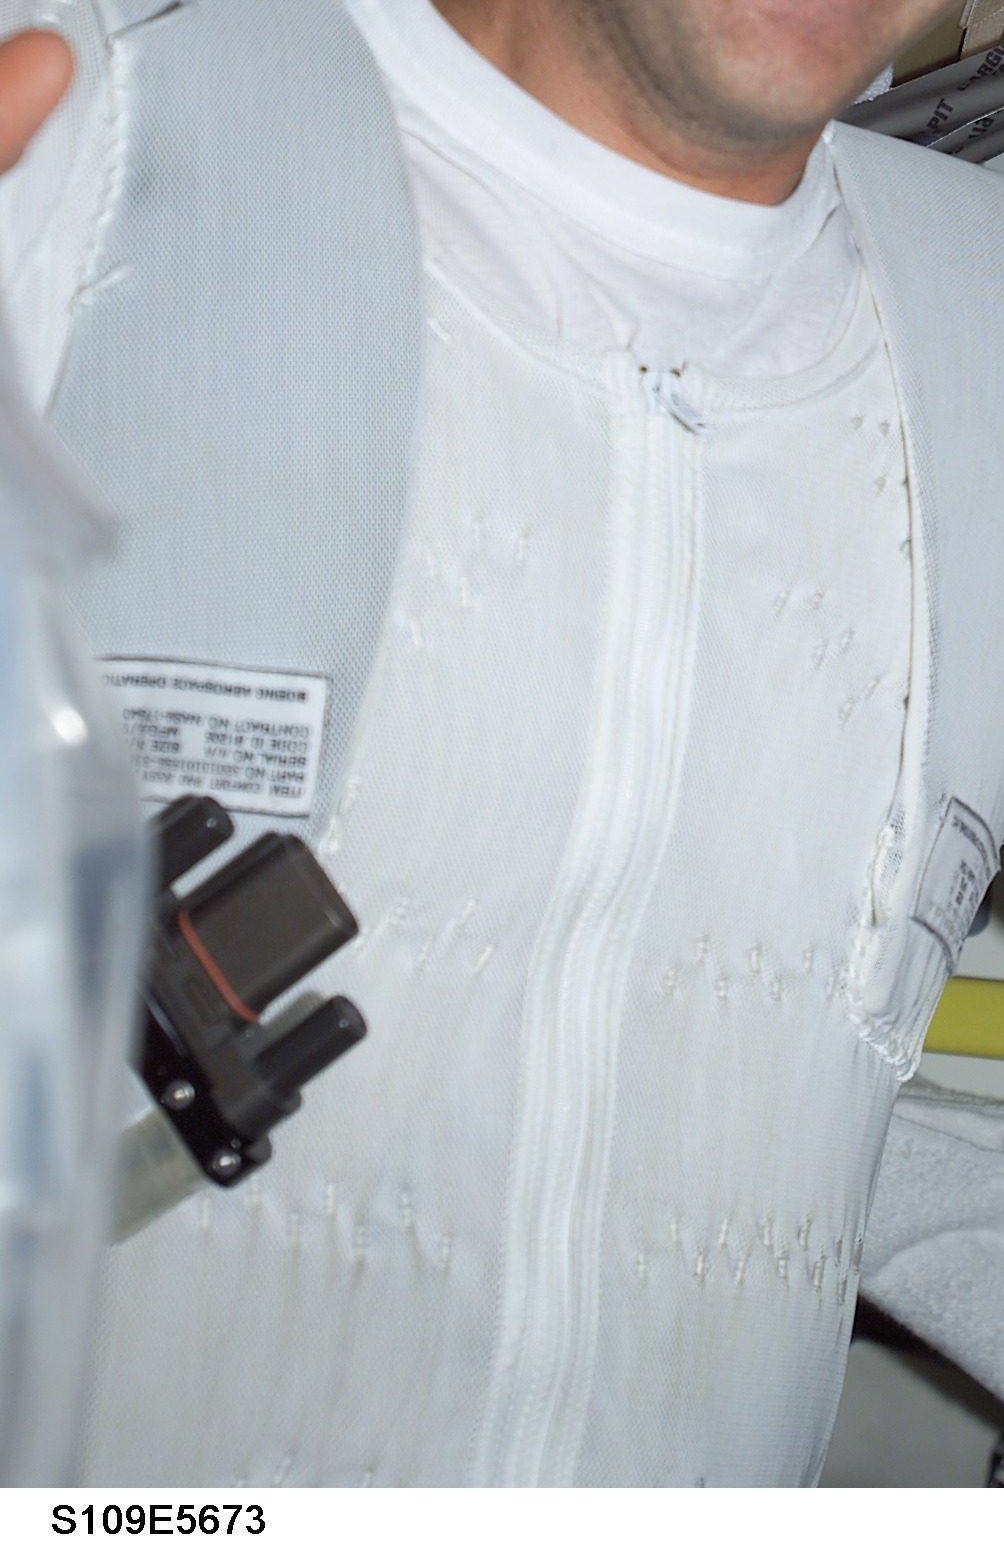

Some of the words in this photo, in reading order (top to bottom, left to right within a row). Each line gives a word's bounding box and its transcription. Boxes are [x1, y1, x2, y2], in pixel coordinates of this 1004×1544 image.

[927, 97, 954, 136] PIT
[172, 678, 252, 697] AEROSPACE
[255, 685, 308, 702] BOEING
